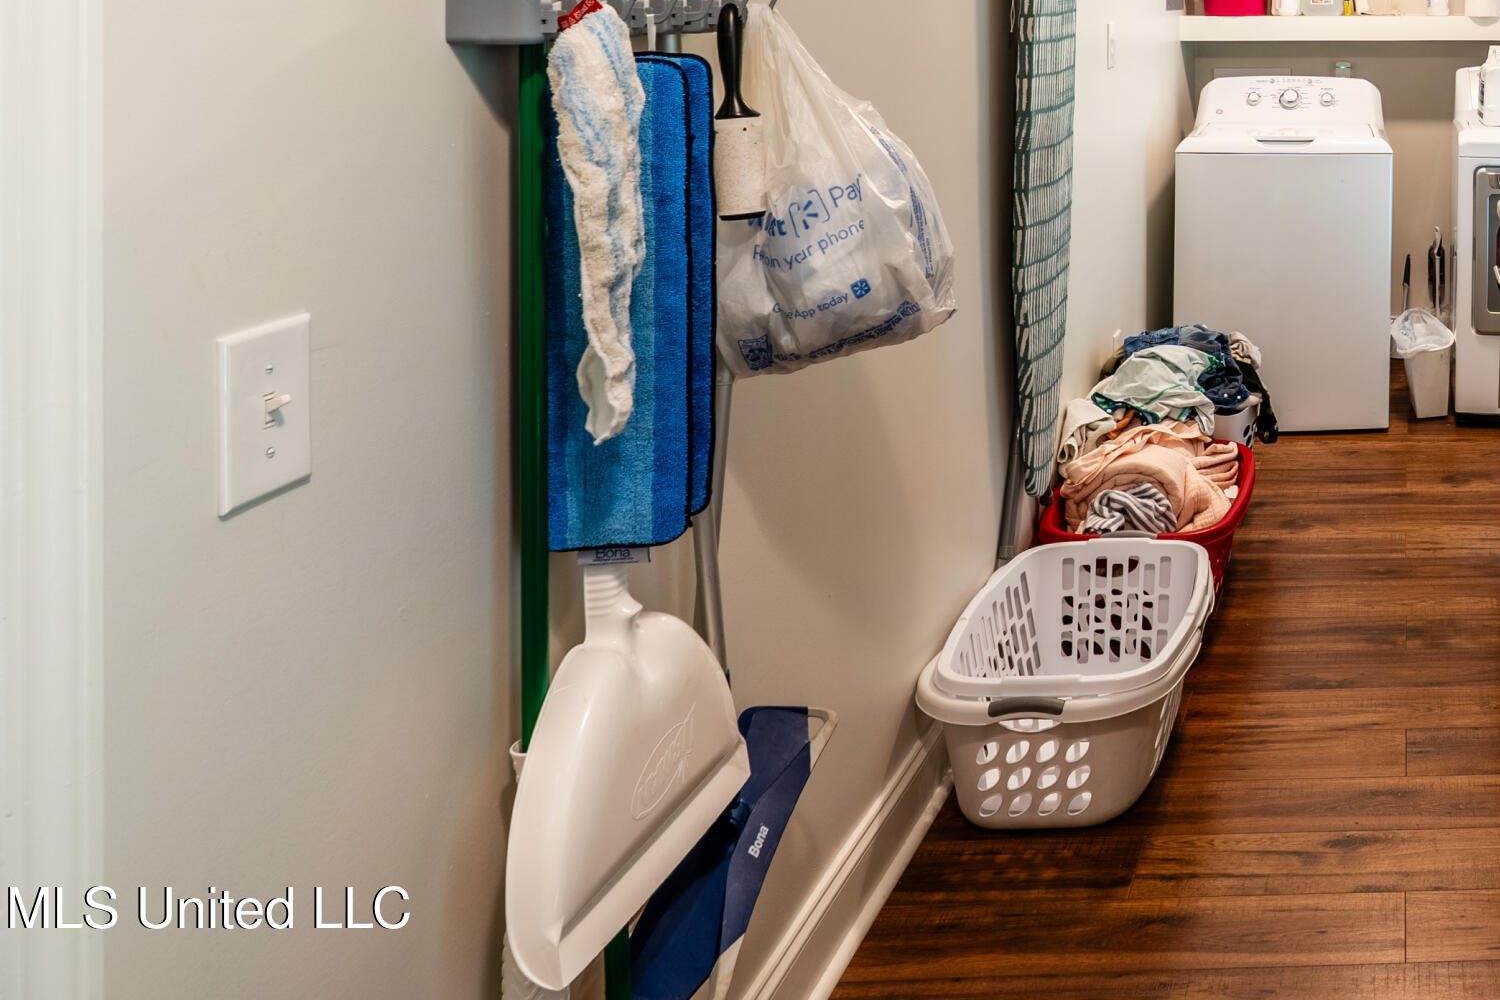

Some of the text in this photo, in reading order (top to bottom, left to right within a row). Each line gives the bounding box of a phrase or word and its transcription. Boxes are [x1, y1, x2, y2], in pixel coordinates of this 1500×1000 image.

[828, 176, 862, 207] Pay
[784, 244, 814, 271] your
[817, 219, 865, 255] phone
[794, 292, 849, 320] App today
[595, 548, 631, 559] Bona
[748, 824, 770, 859] Bona
